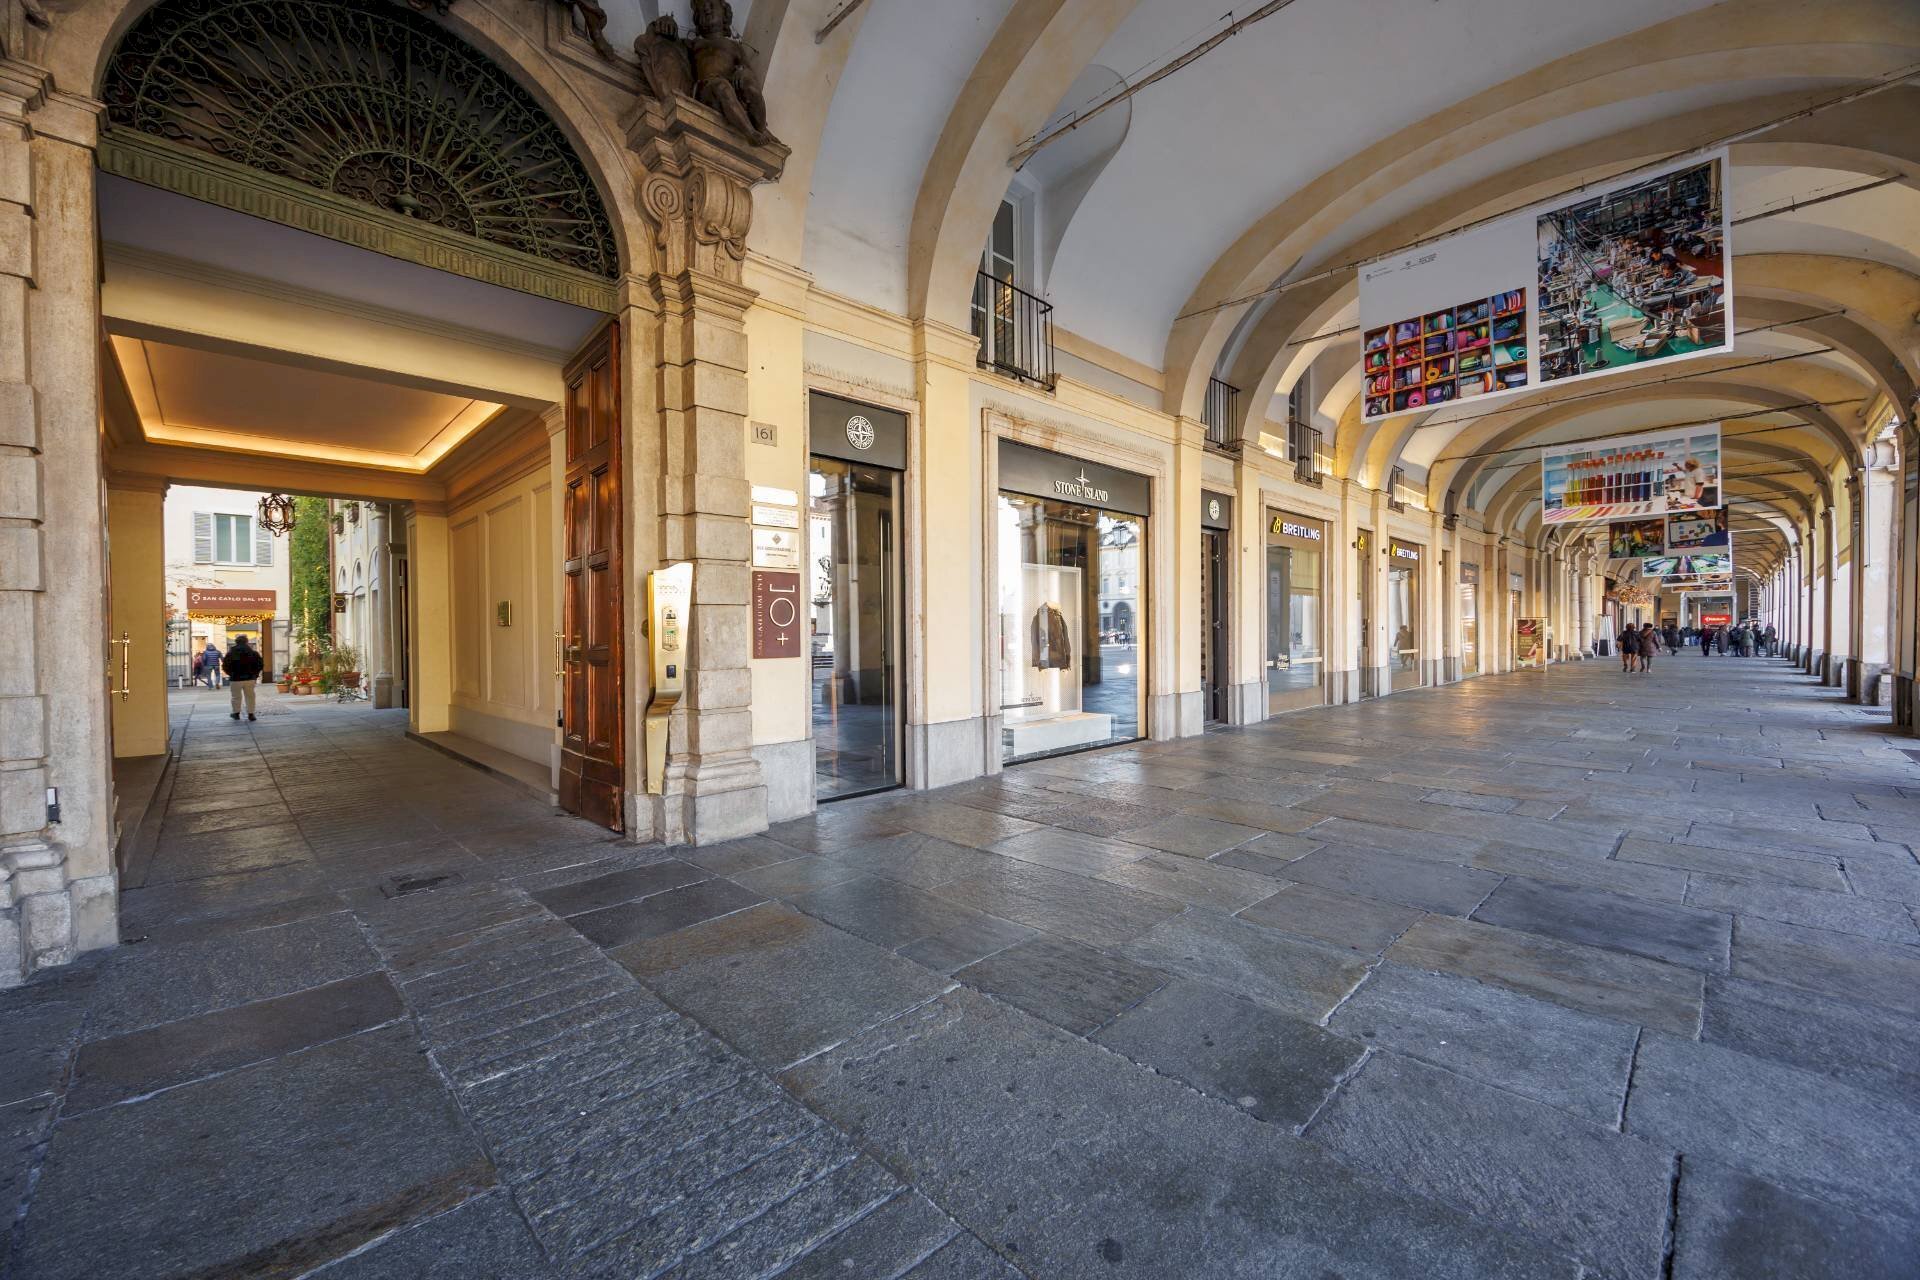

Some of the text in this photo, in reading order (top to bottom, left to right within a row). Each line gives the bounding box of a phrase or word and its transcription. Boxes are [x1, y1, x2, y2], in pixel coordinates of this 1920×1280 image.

[756, 426, 773, 441] 161
[1055, 480, 1108, 502] STONE ISLAND
[1282, 522, 1320, 540] BREITLING
[1396, 547, 1419, 560] BREITLING
